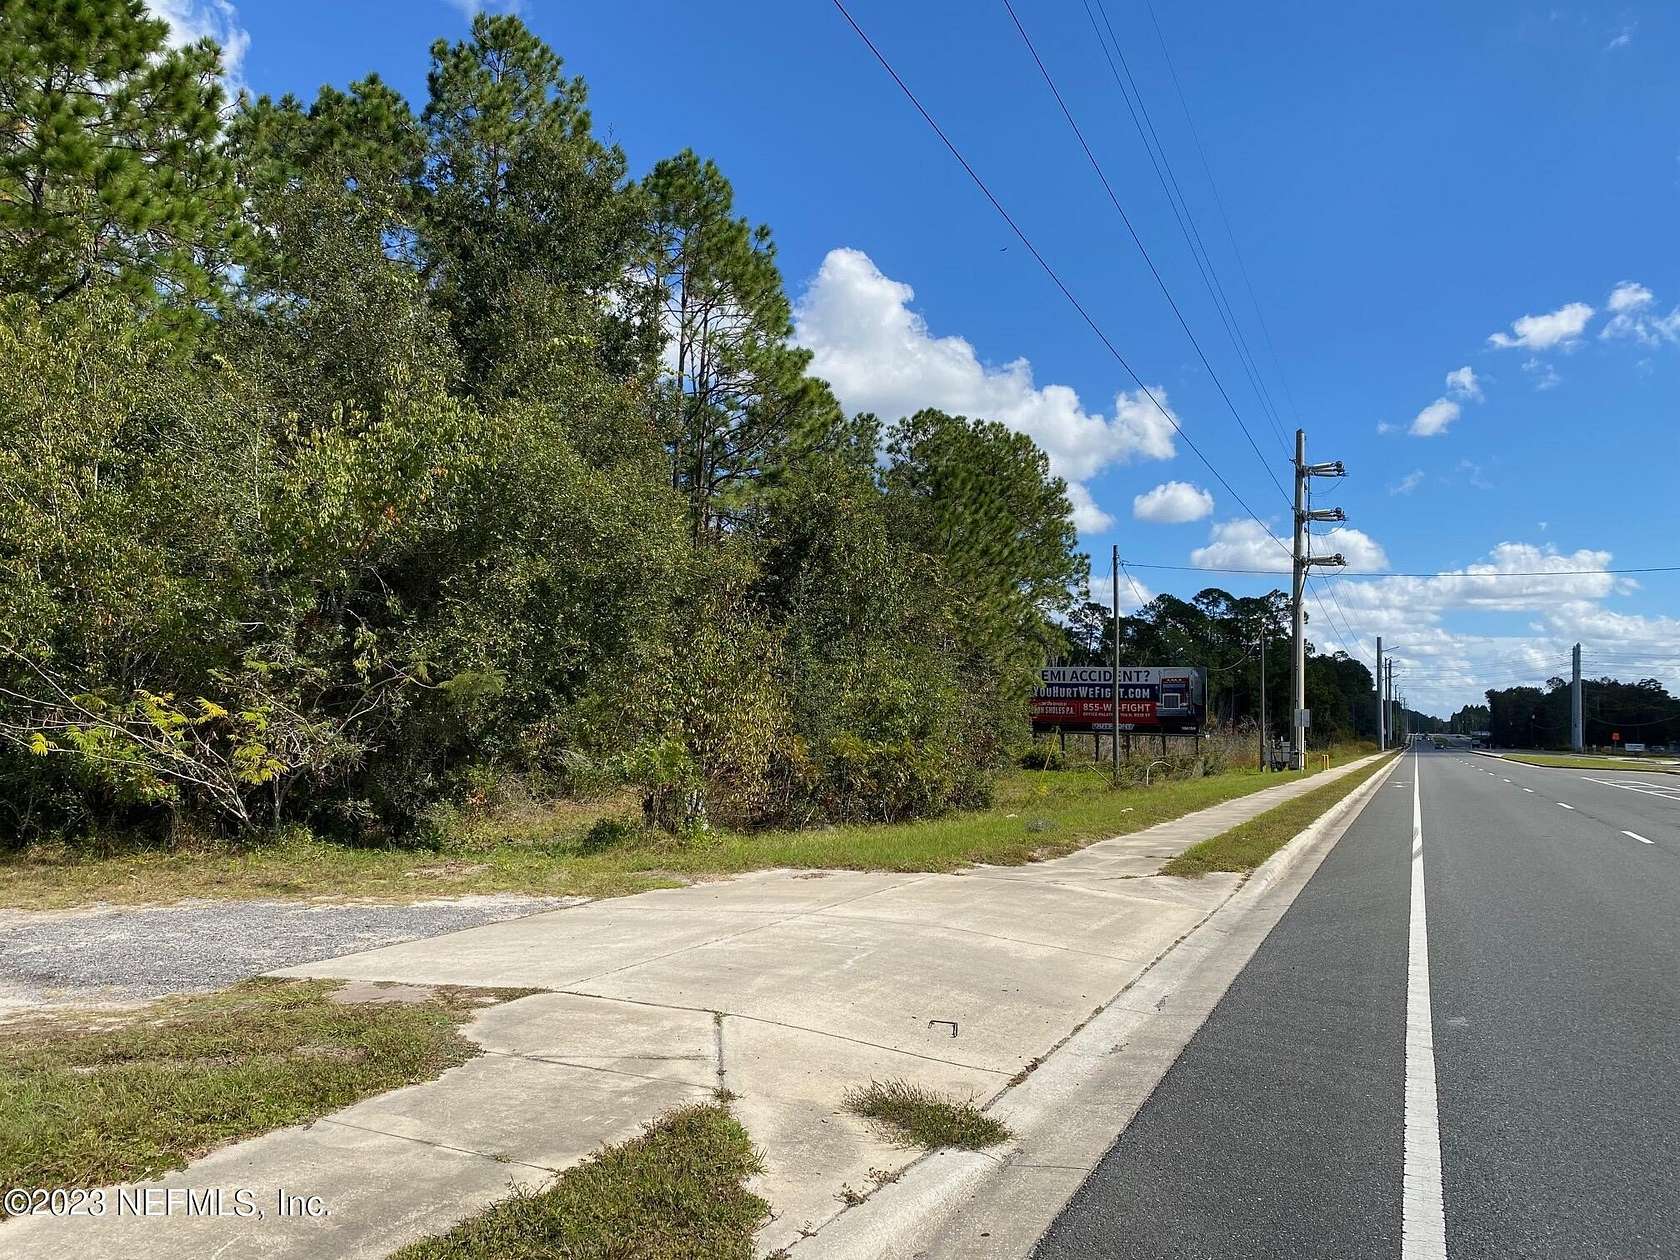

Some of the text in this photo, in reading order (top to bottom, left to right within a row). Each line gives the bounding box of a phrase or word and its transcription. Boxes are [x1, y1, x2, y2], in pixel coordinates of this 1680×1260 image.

[1041, 670, 1066, 682] EMI
[1033, 686, 1150, 699] YOUHURTWEFIGT.COM
[1082, 703, 1151, 713] 855-W-FIGHT
